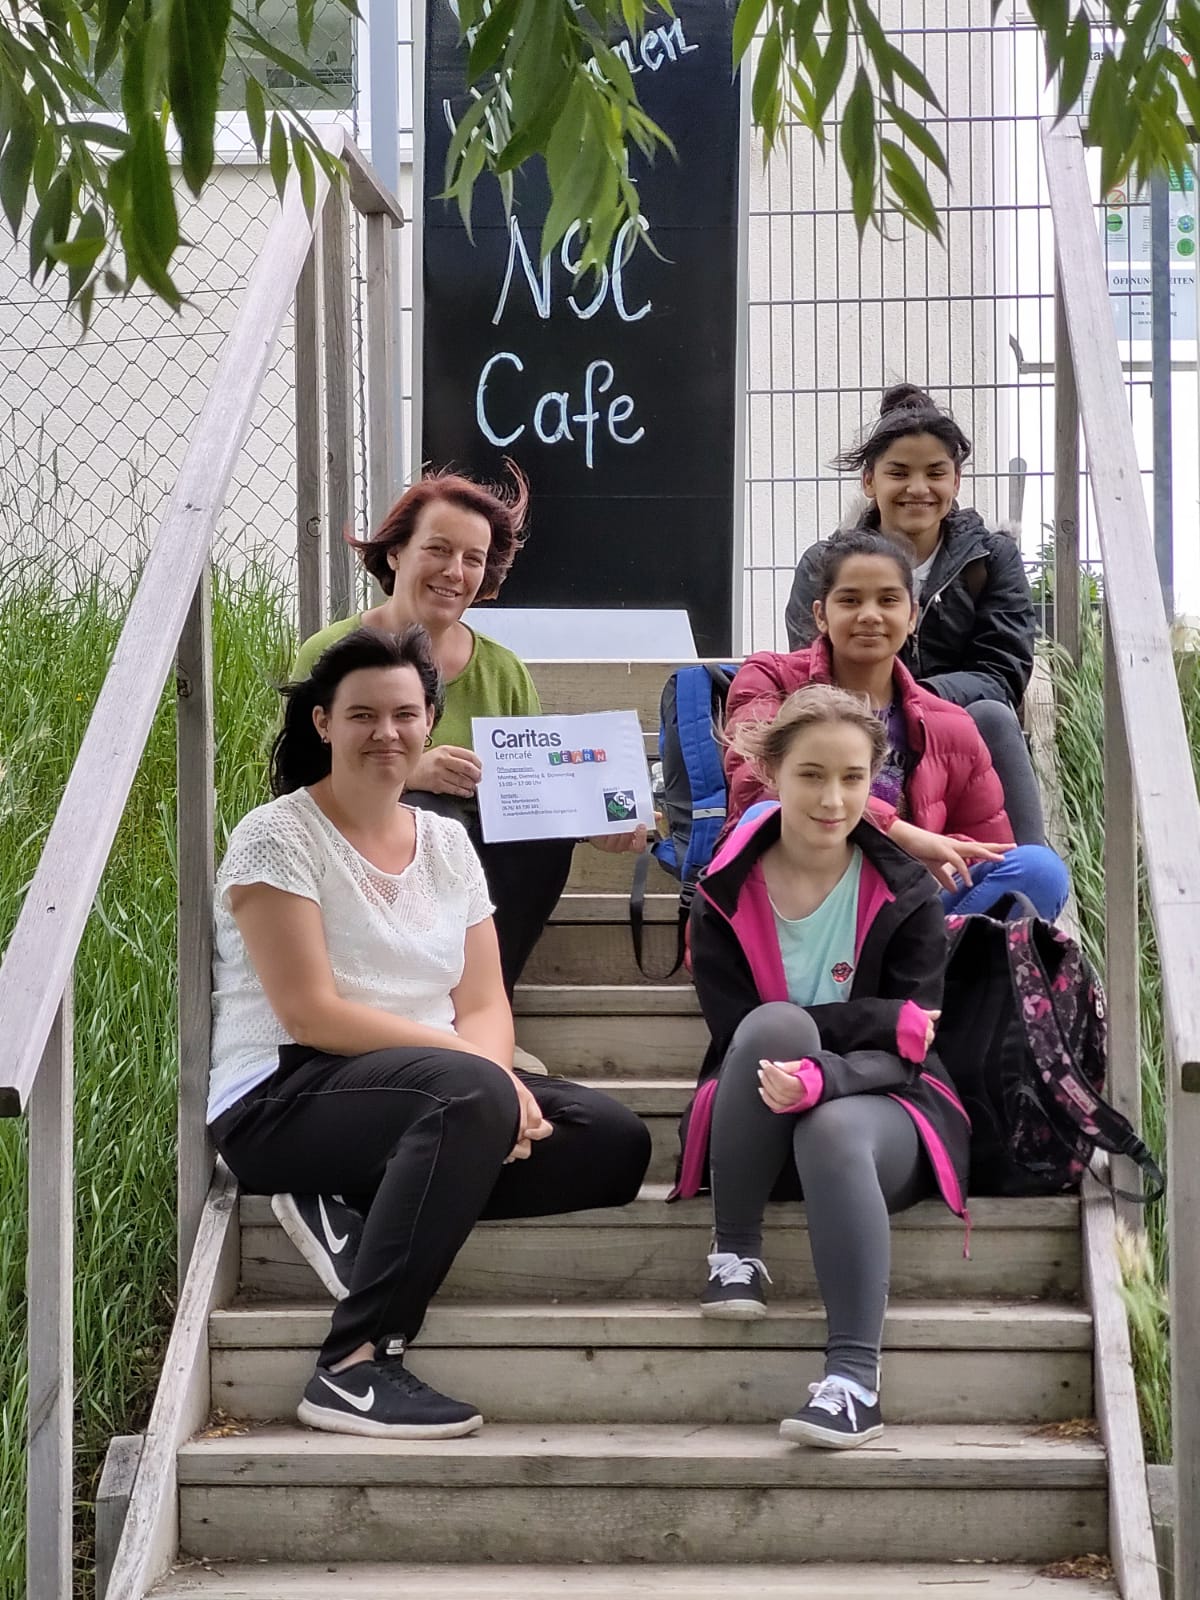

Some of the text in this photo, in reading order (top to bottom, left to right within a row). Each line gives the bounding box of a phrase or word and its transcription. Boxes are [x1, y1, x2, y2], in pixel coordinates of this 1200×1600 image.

[476, 351, 645, 470] Cafe
[491, 728, 562, 749] Caritas
[495, 751, 533, 760] Lerncafé
[551, 751, 606, 765] LEARN
